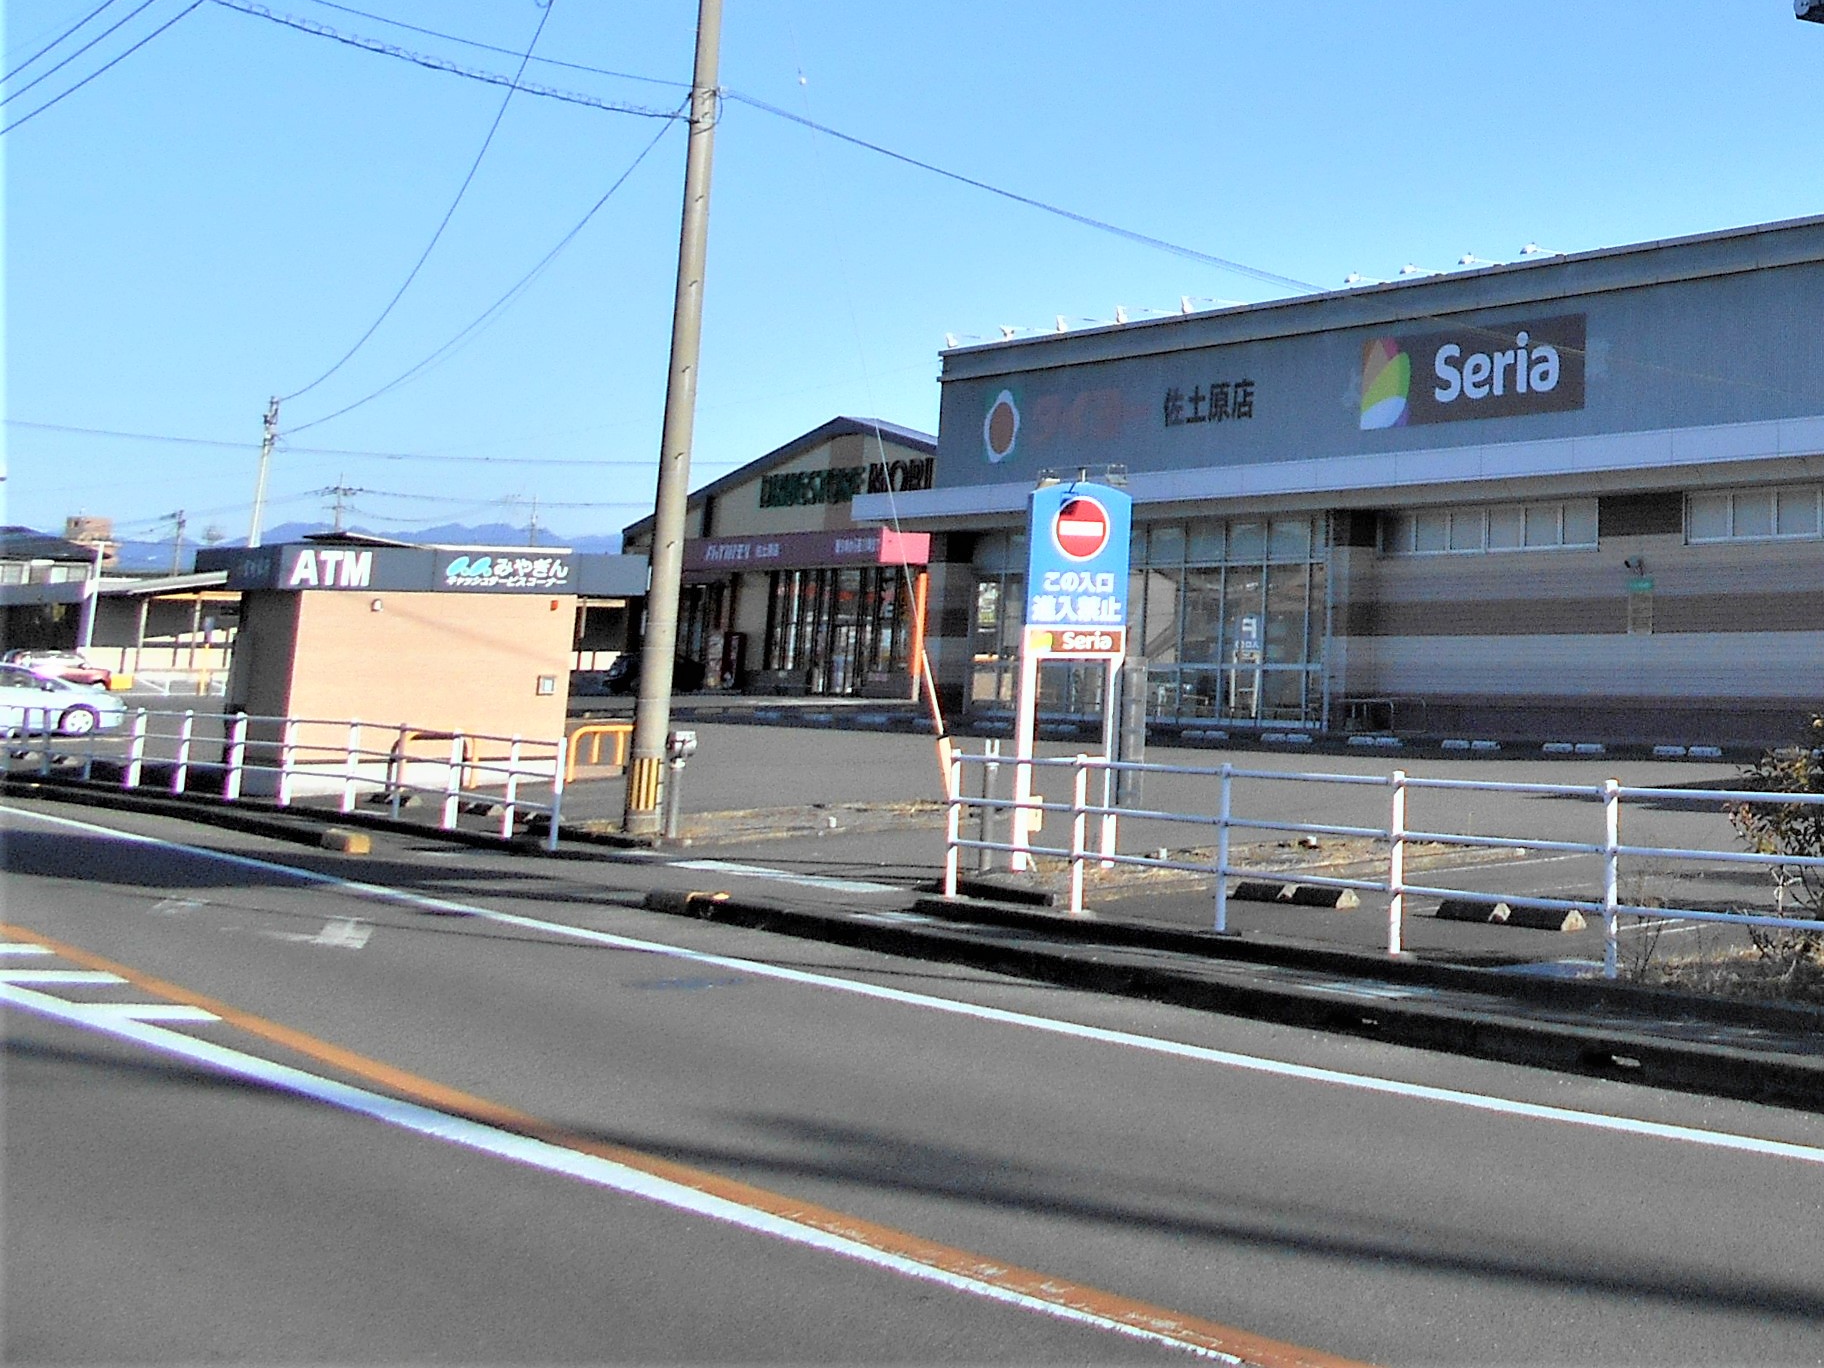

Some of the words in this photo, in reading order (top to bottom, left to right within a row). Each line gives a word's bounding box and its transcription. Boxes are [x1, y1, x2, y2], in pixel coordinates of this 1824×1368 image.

[1433, 331, 1561, 404] Seria
[1163, 377, 1256, 428] 佐土原店
[290, 549, 373, 587] ATM
[493, 557, 569, 578] みやぎん
[1043, 571, 1115, 593] この入口
[1062, 631, 1114, 650] Seria
